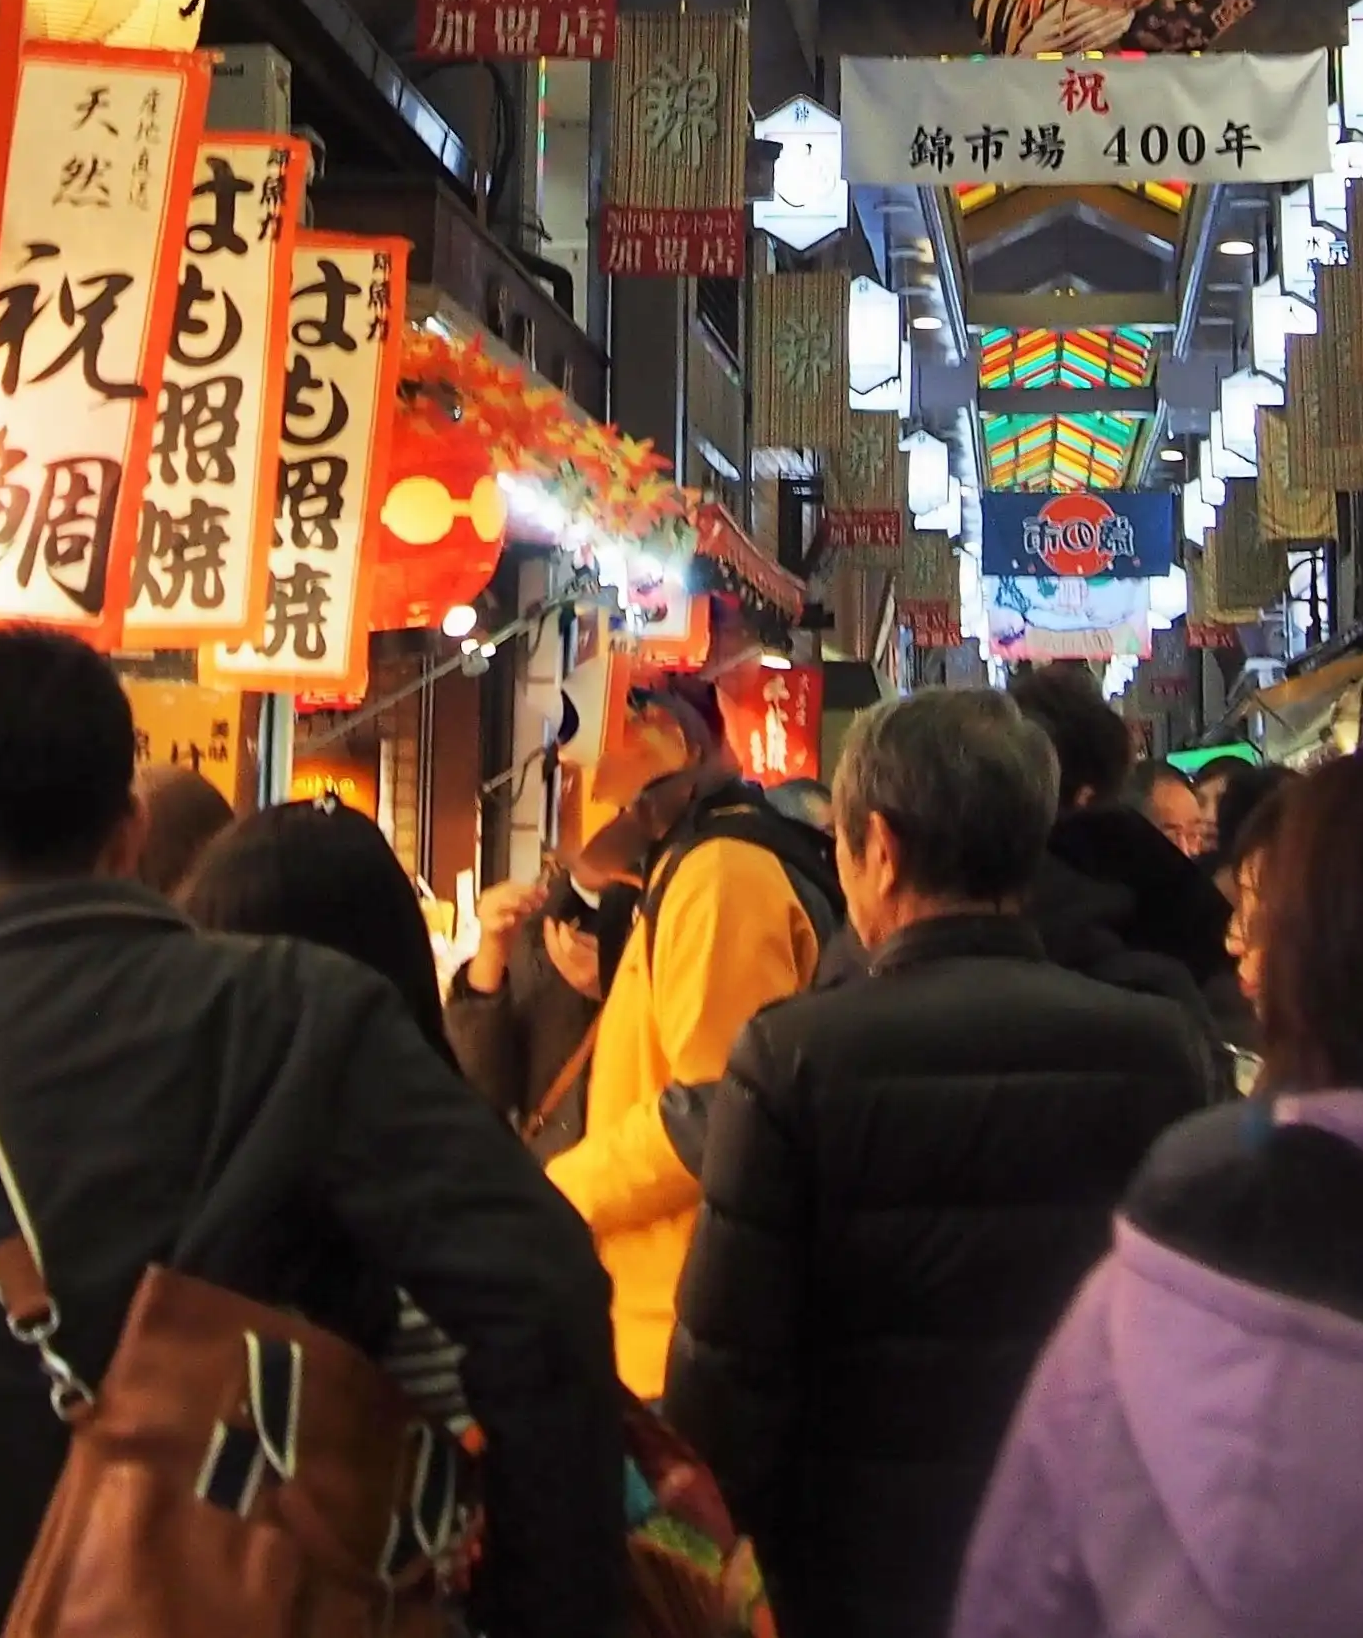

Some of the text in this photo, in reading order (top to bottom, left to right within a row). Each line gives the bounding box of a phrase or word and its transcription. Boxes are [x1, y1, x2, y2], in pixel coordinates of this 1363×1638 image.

[429, 3, 607, 58] 加盟店
[1058, 66, 1112, 117] 祝
[51, 86, 120, 210] 天然
[909, 118, 1263, 174] 錦市場 400年
[609, 236, 737, 274] 加盟店
